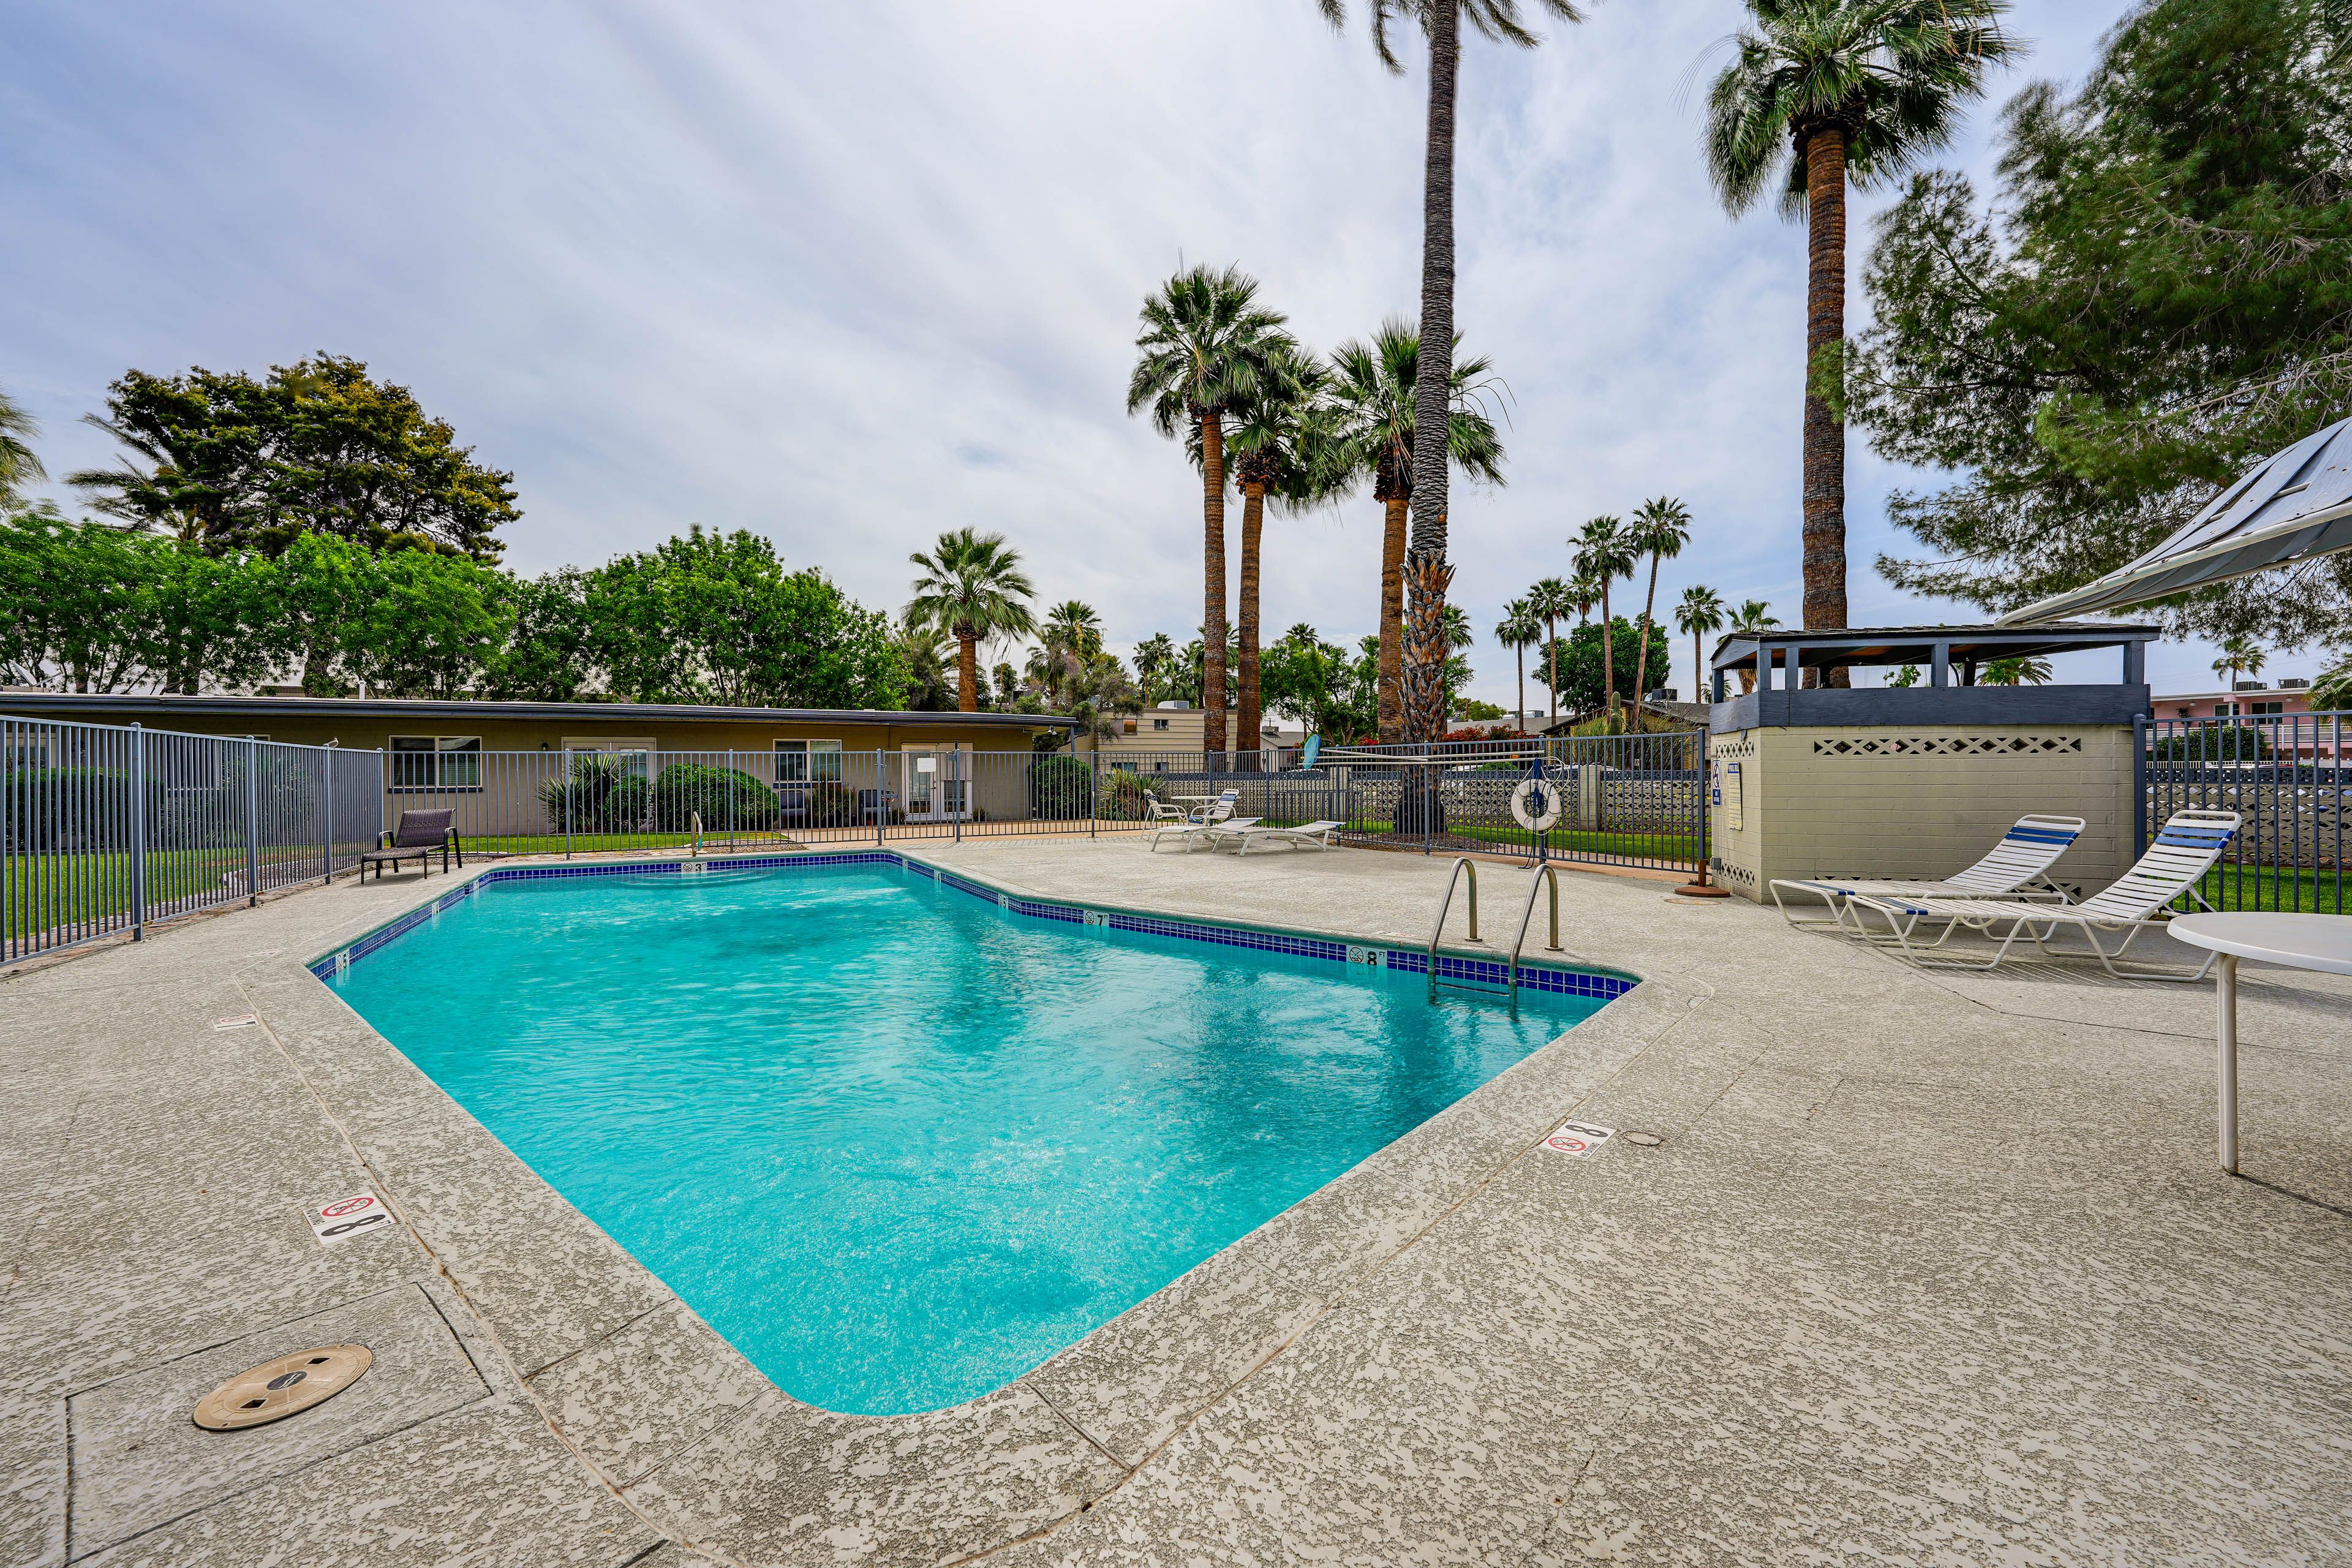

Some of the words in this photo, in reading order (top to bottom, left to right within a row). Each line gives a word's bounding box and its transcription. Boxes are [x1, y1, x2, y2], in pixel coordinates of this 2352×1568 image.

[1097, 914, 1103, 926] 7
[343, 953, 347, 968] 5
[1367, 951, 1377, 966] 8
[1565, 1125, 1608, 1137] 8
[321, 1215, 386, 1237] 8
